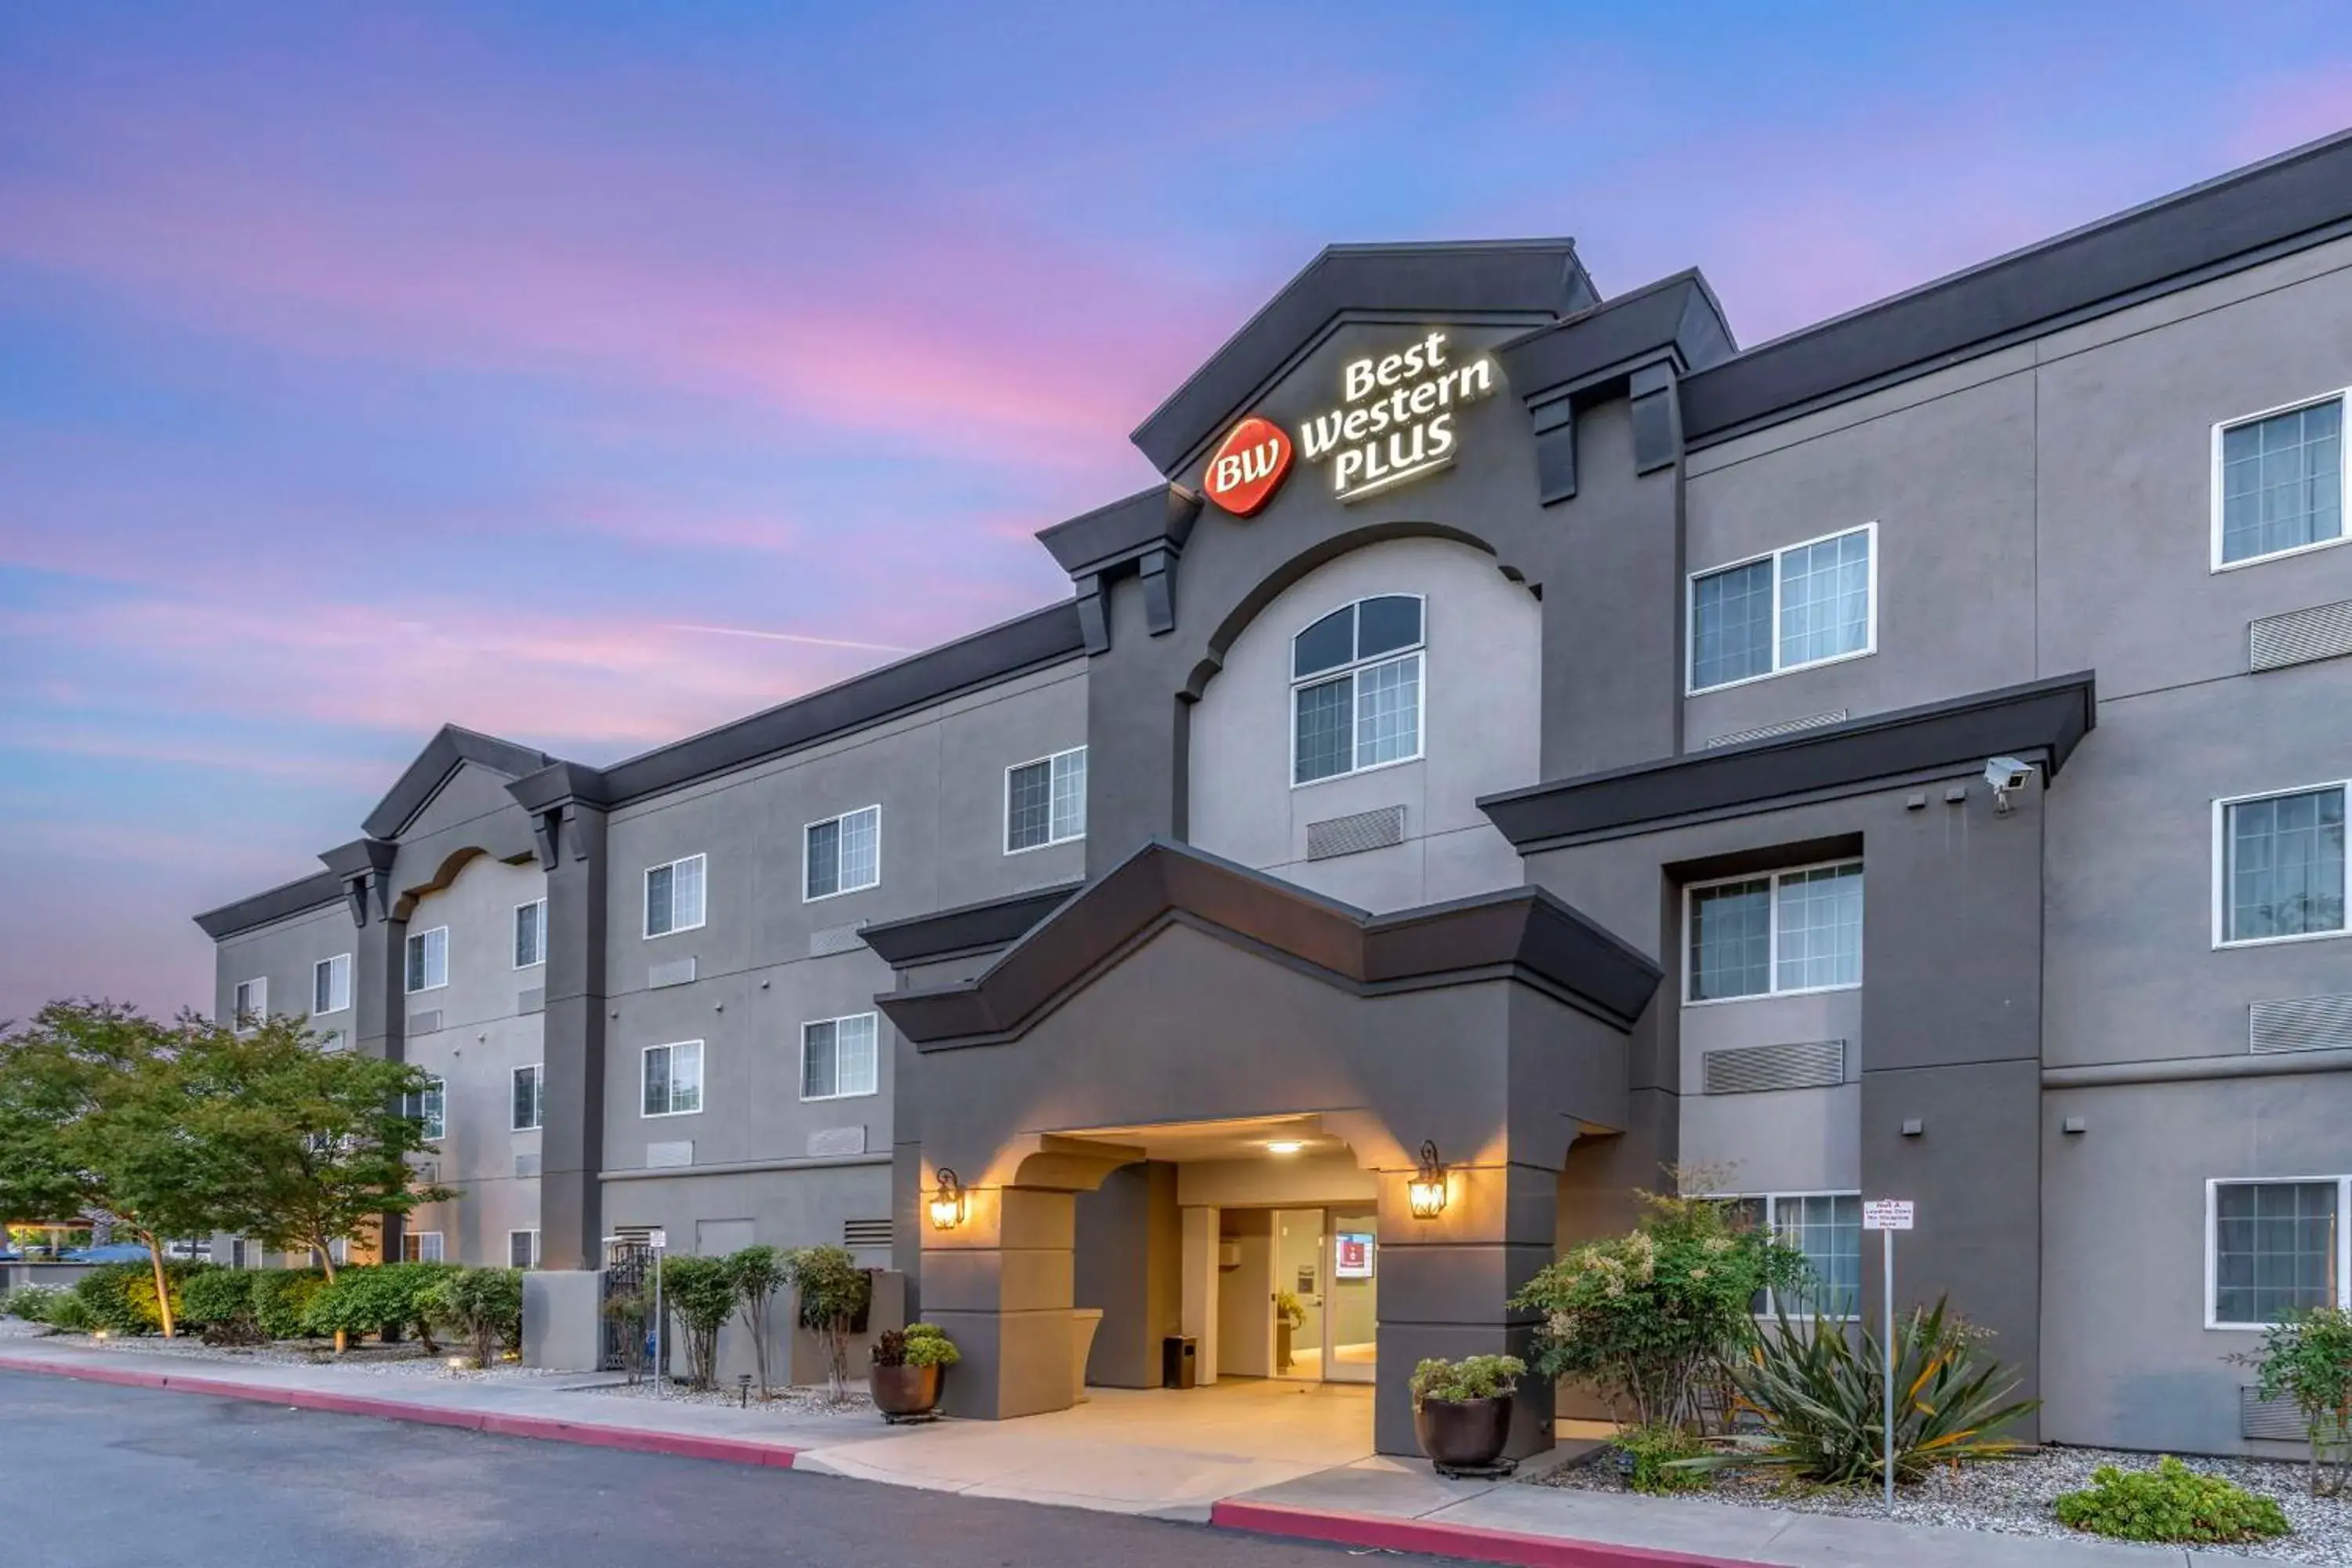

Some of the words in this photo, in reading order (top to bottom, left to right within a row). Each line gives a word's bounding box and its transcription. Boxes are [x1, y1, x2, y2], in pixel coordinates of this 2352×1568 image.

[1345, 331, 1446, 402] Best
[1301, 358, 1491, 459] Western
[1216, 437, 1279, 493] BW
[1334, 413, 1453, 491] PLUS
